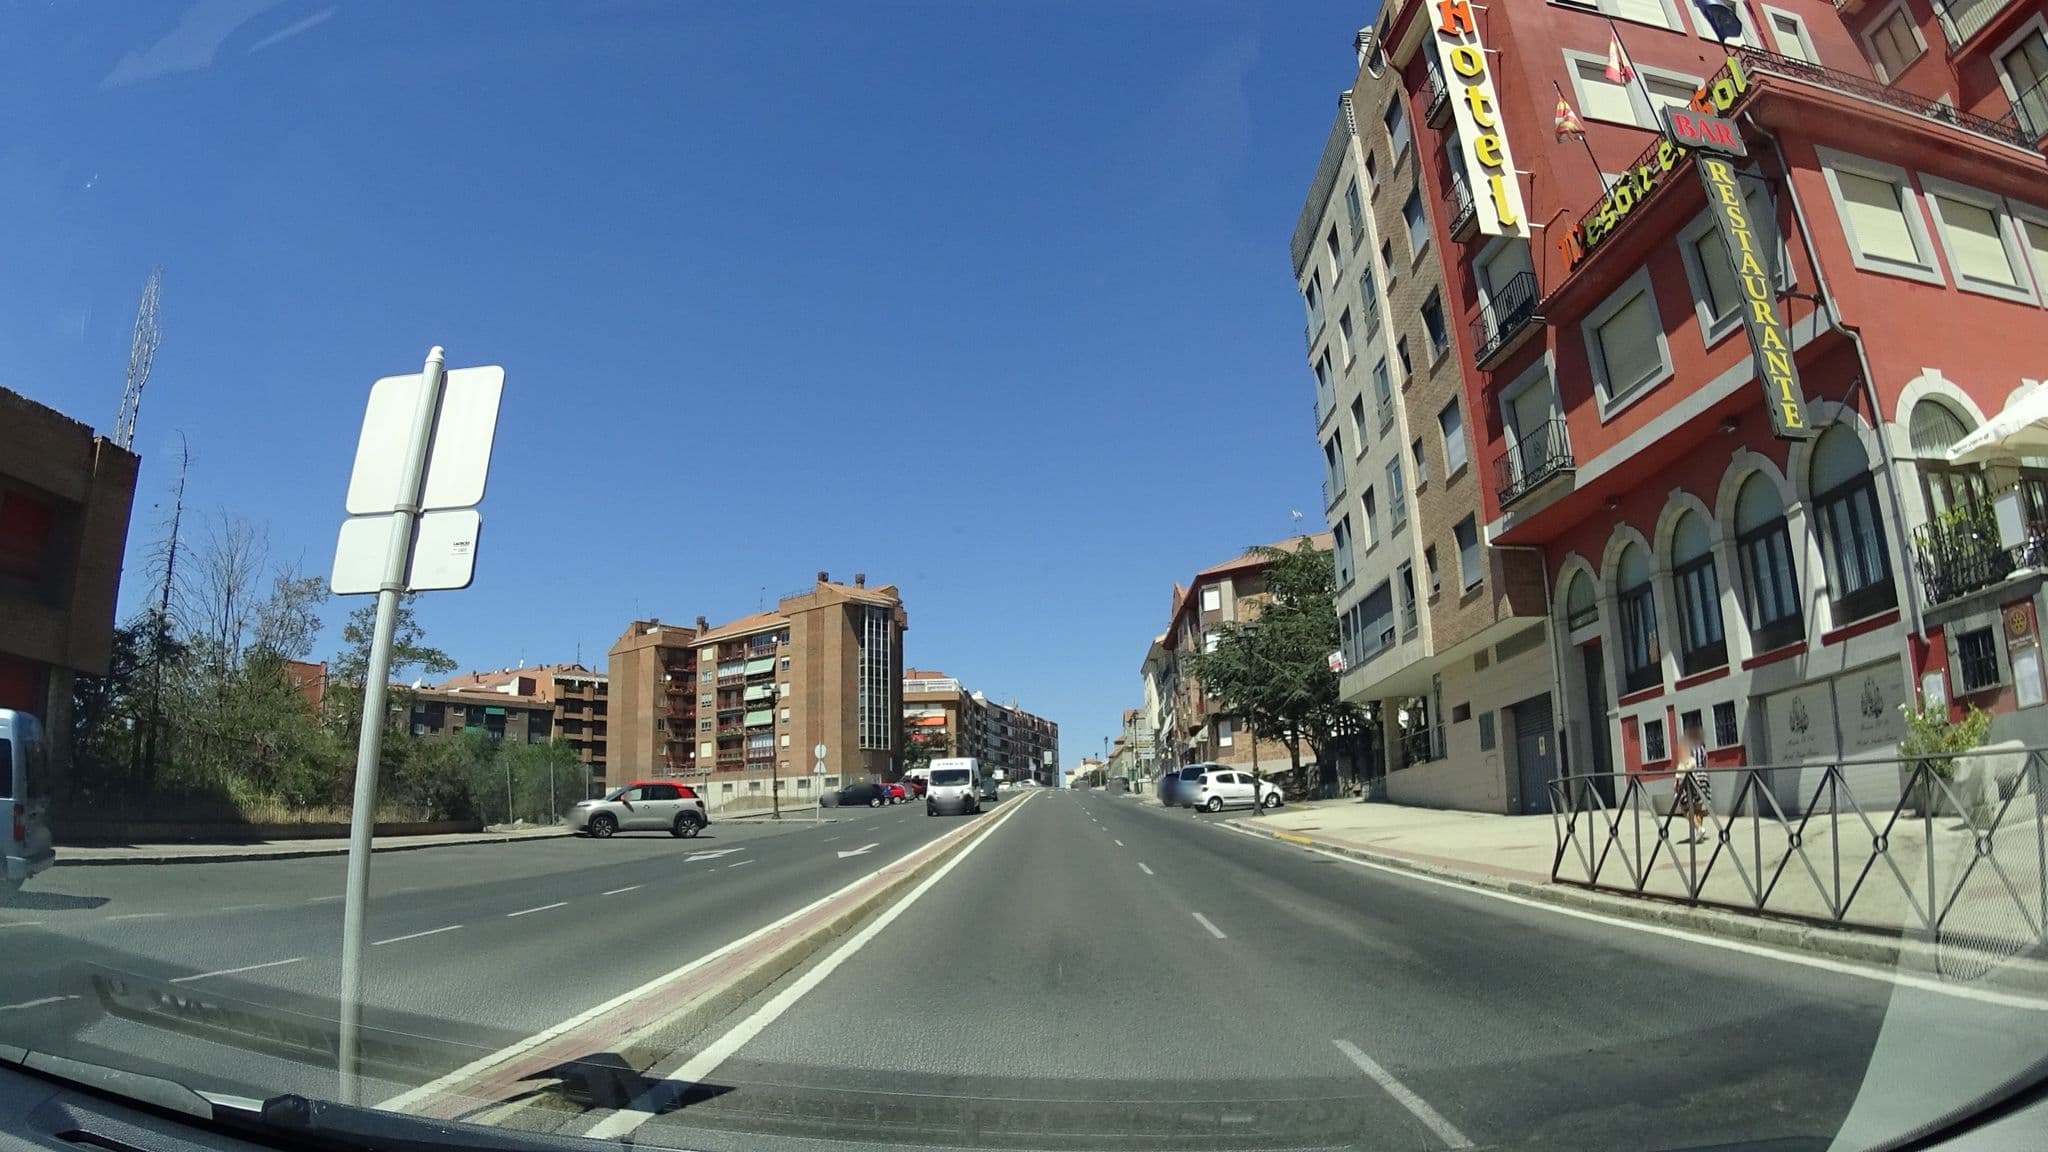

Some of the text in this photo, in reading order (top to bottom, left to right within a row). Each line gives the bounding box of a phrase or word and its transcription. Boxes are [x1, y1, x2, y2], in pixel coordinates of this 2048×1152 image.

[1437, 1, 1518, 226] Hotel
[1674, 113, 1738, 149] BAR
[1705, 159, 1804, 429] RESTAURANTE
